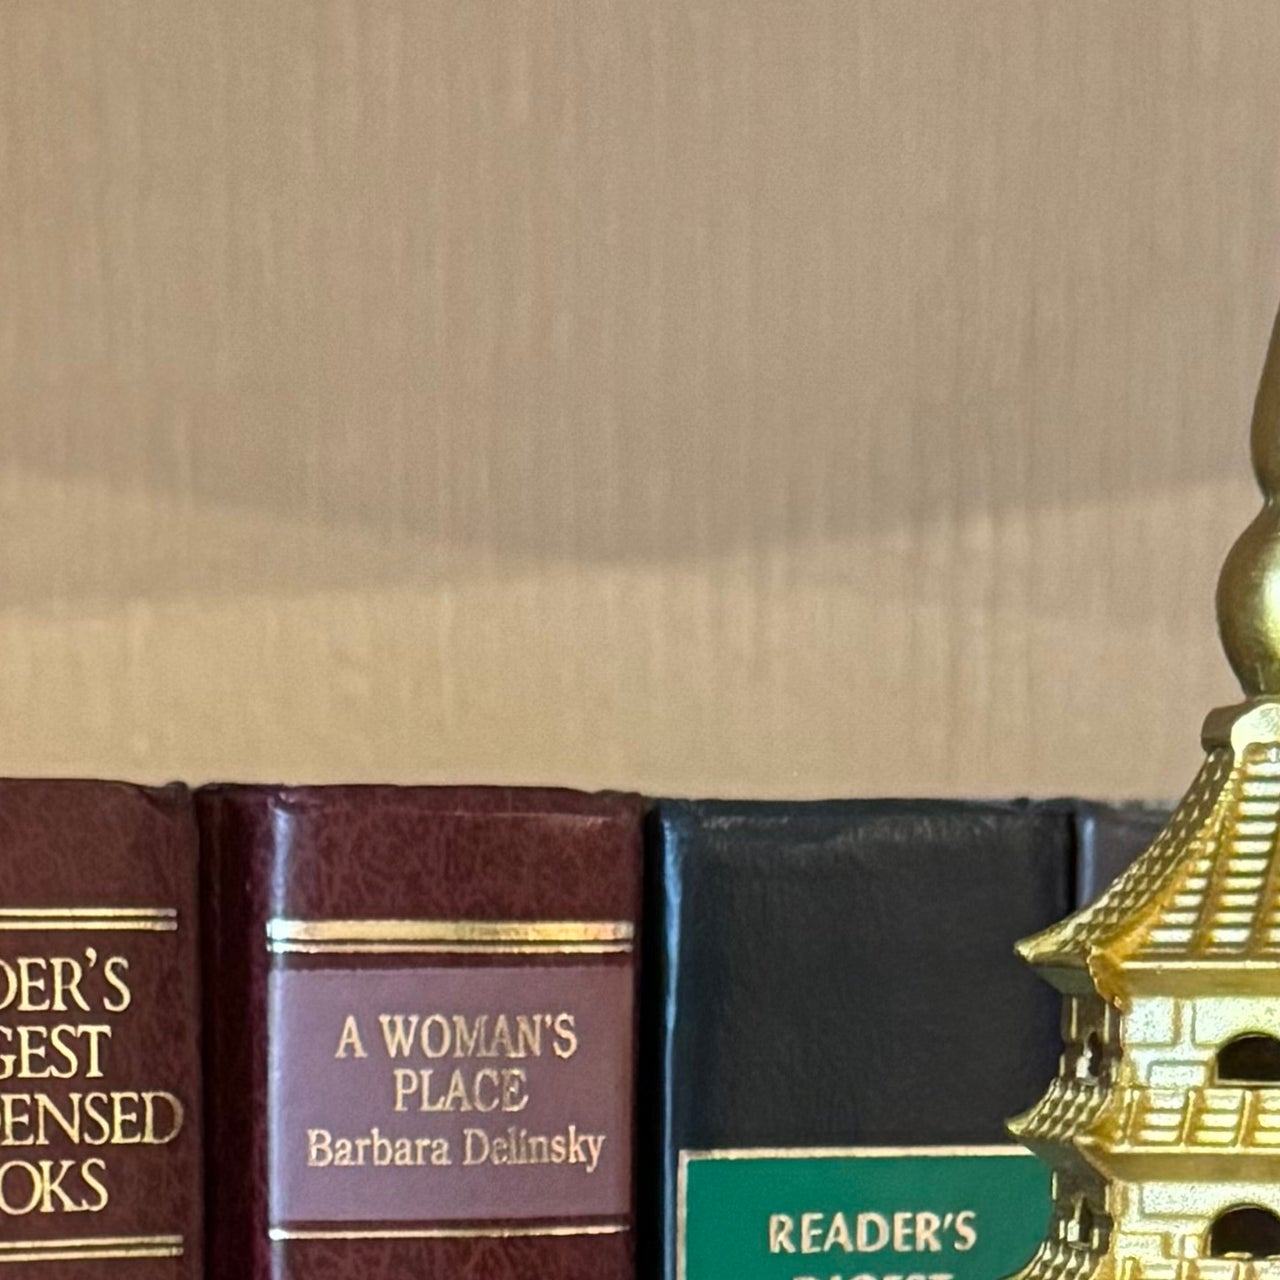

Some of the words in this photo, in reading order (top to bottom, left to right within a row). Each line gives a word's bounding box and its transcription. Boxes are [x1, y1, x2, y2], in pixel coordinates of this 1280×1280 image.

[335, 1016, 366, 1059] A
[379, 1013, 578, 1060] WOMAN'S
[393, 1069, 529, 1113] PLACE
[307, 1129, 452, 1168] Barbara
[463, 1126, 606, 1172] Delinsky
[768, 1210, 978, 1254] READER'S
